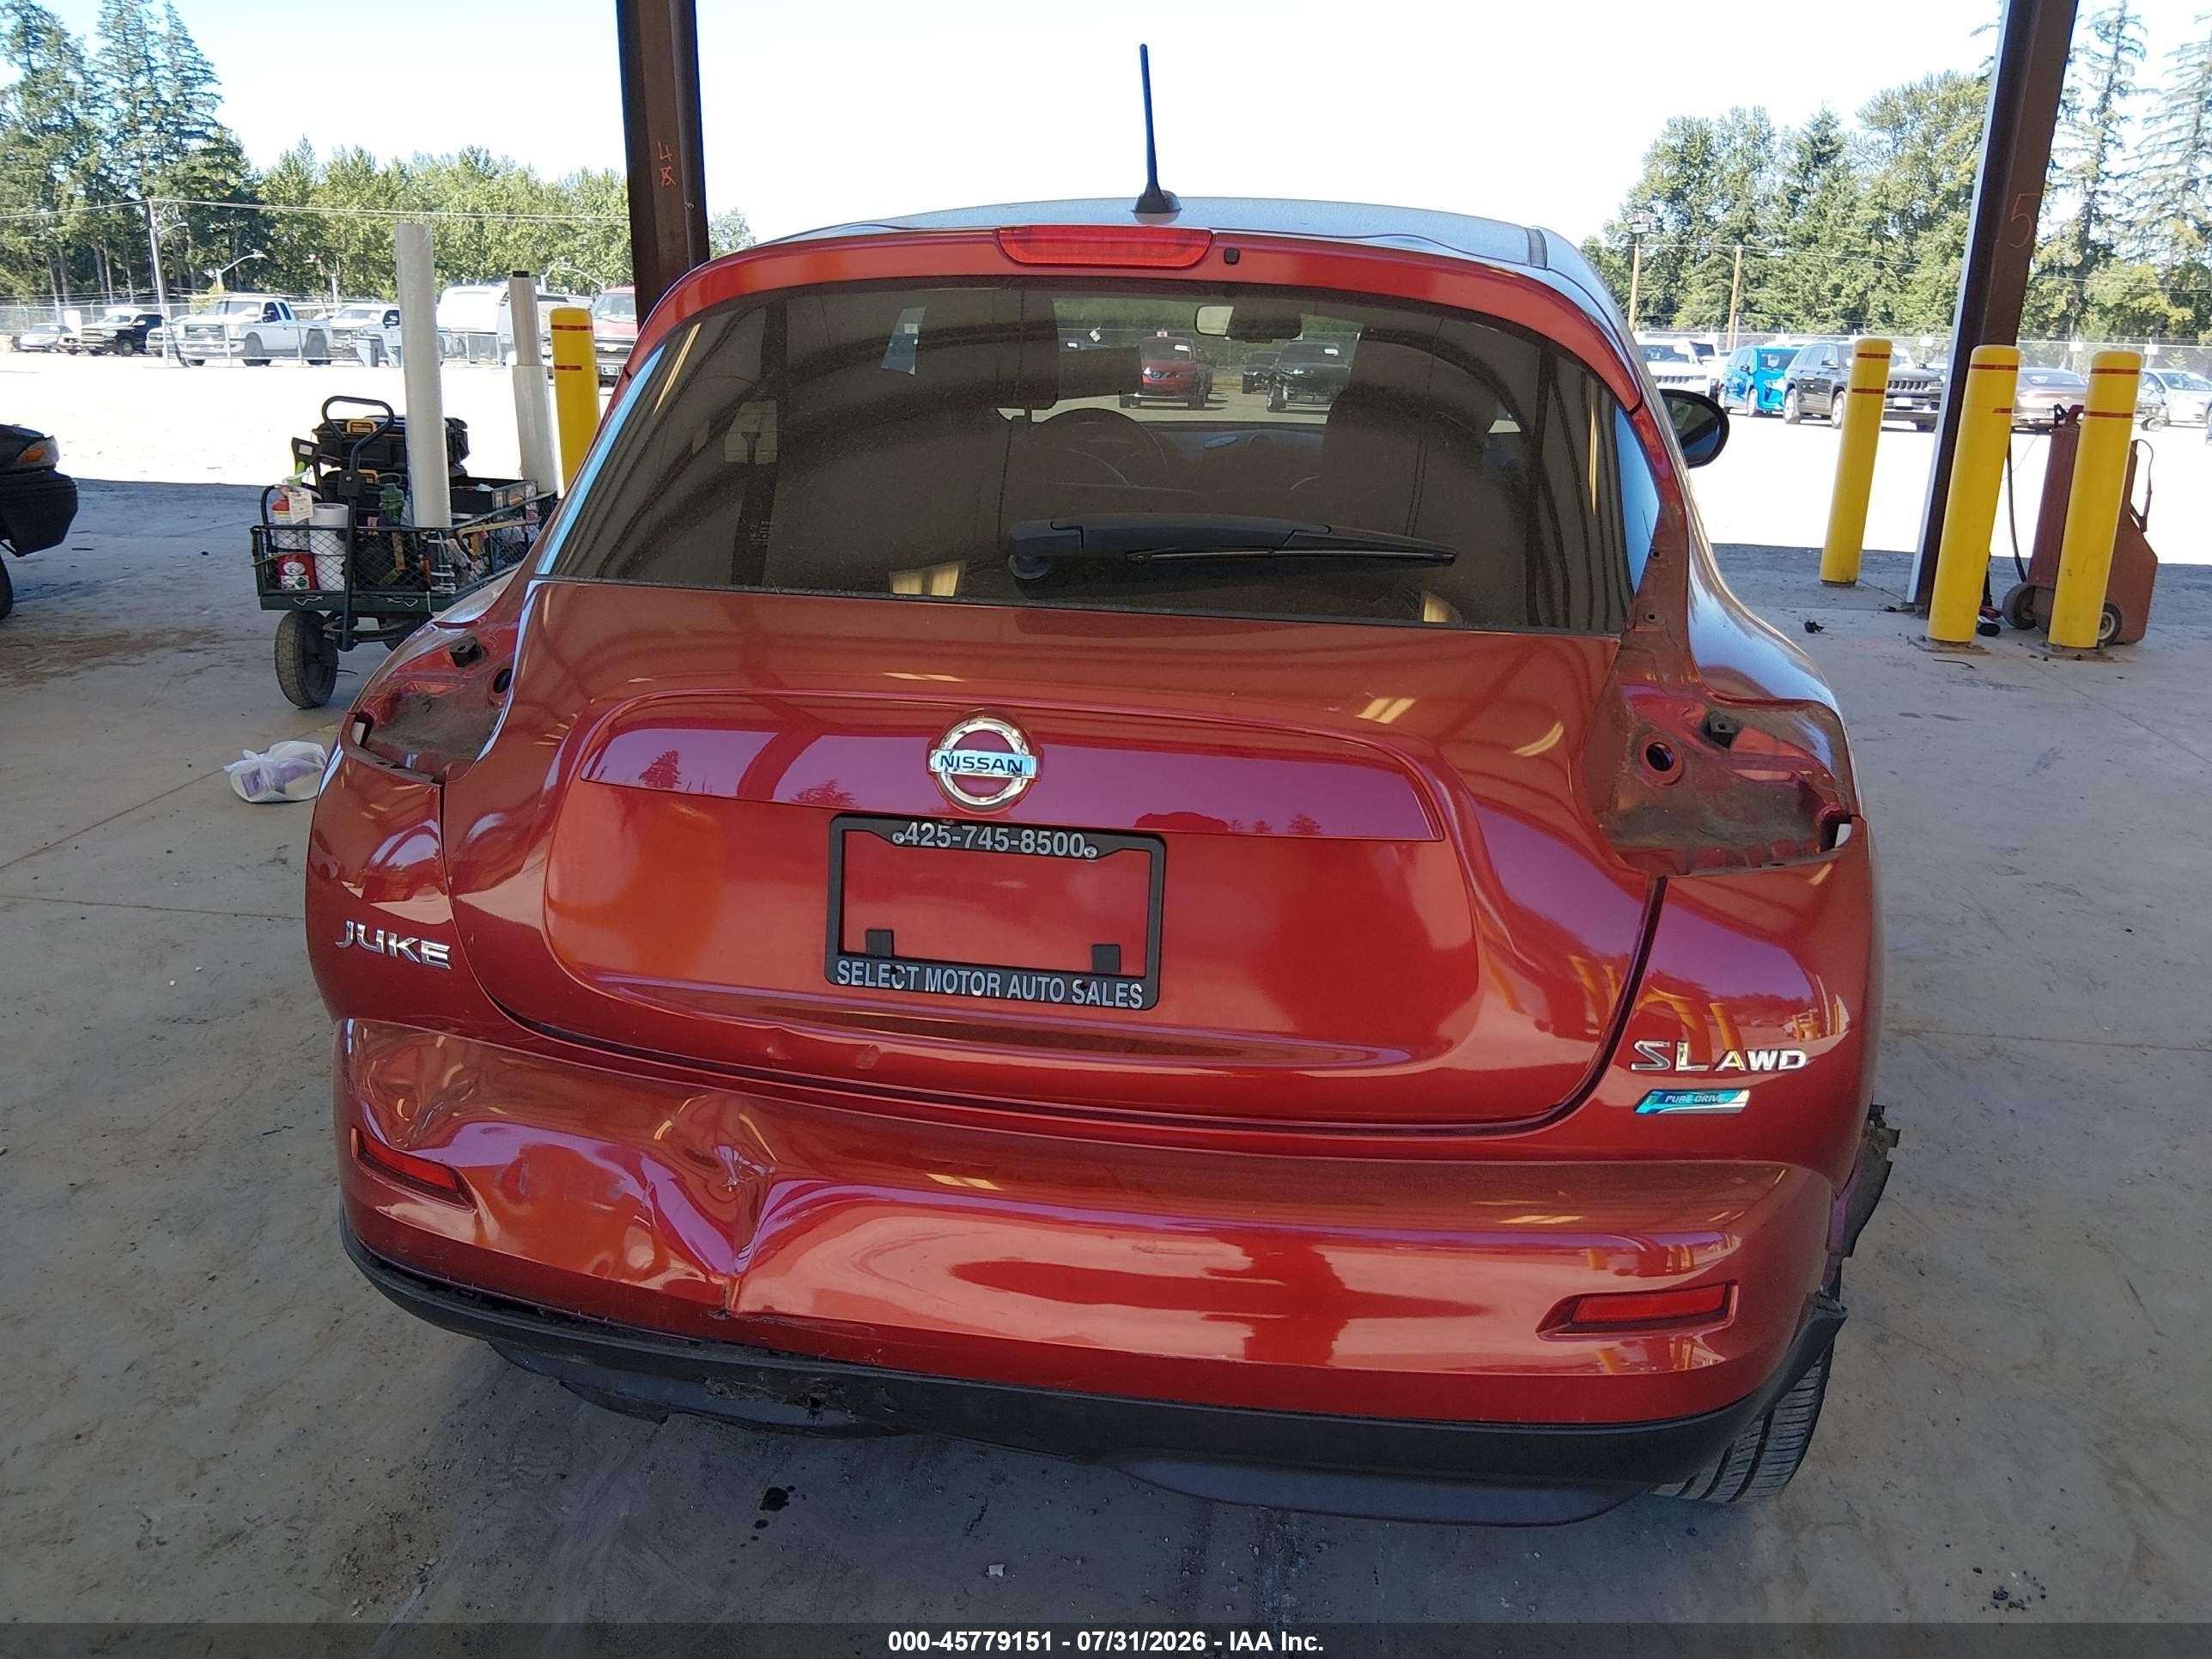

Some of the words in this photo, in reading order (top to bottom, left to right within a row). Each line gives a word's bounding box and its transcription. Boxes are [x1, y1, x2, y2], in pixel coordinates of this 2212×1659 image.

[2008, 193, 2042, 248] 5
[939, 754, 1024, 774] NISSAN
[904, 822, 1085, 858] 425-745-8500
[335, 920, 453, 970] JUKE
[836, 959, 920, 990] SELECT
[925, 967, 1001, 998] MOTOR
[1006, 975, 1066, 1003] AUTO
[1072, 979, 1144, 1010] SALES
[1631, 1040, 1710, 1072] SL
[1715, 1049, 1807, 1072] AWD
